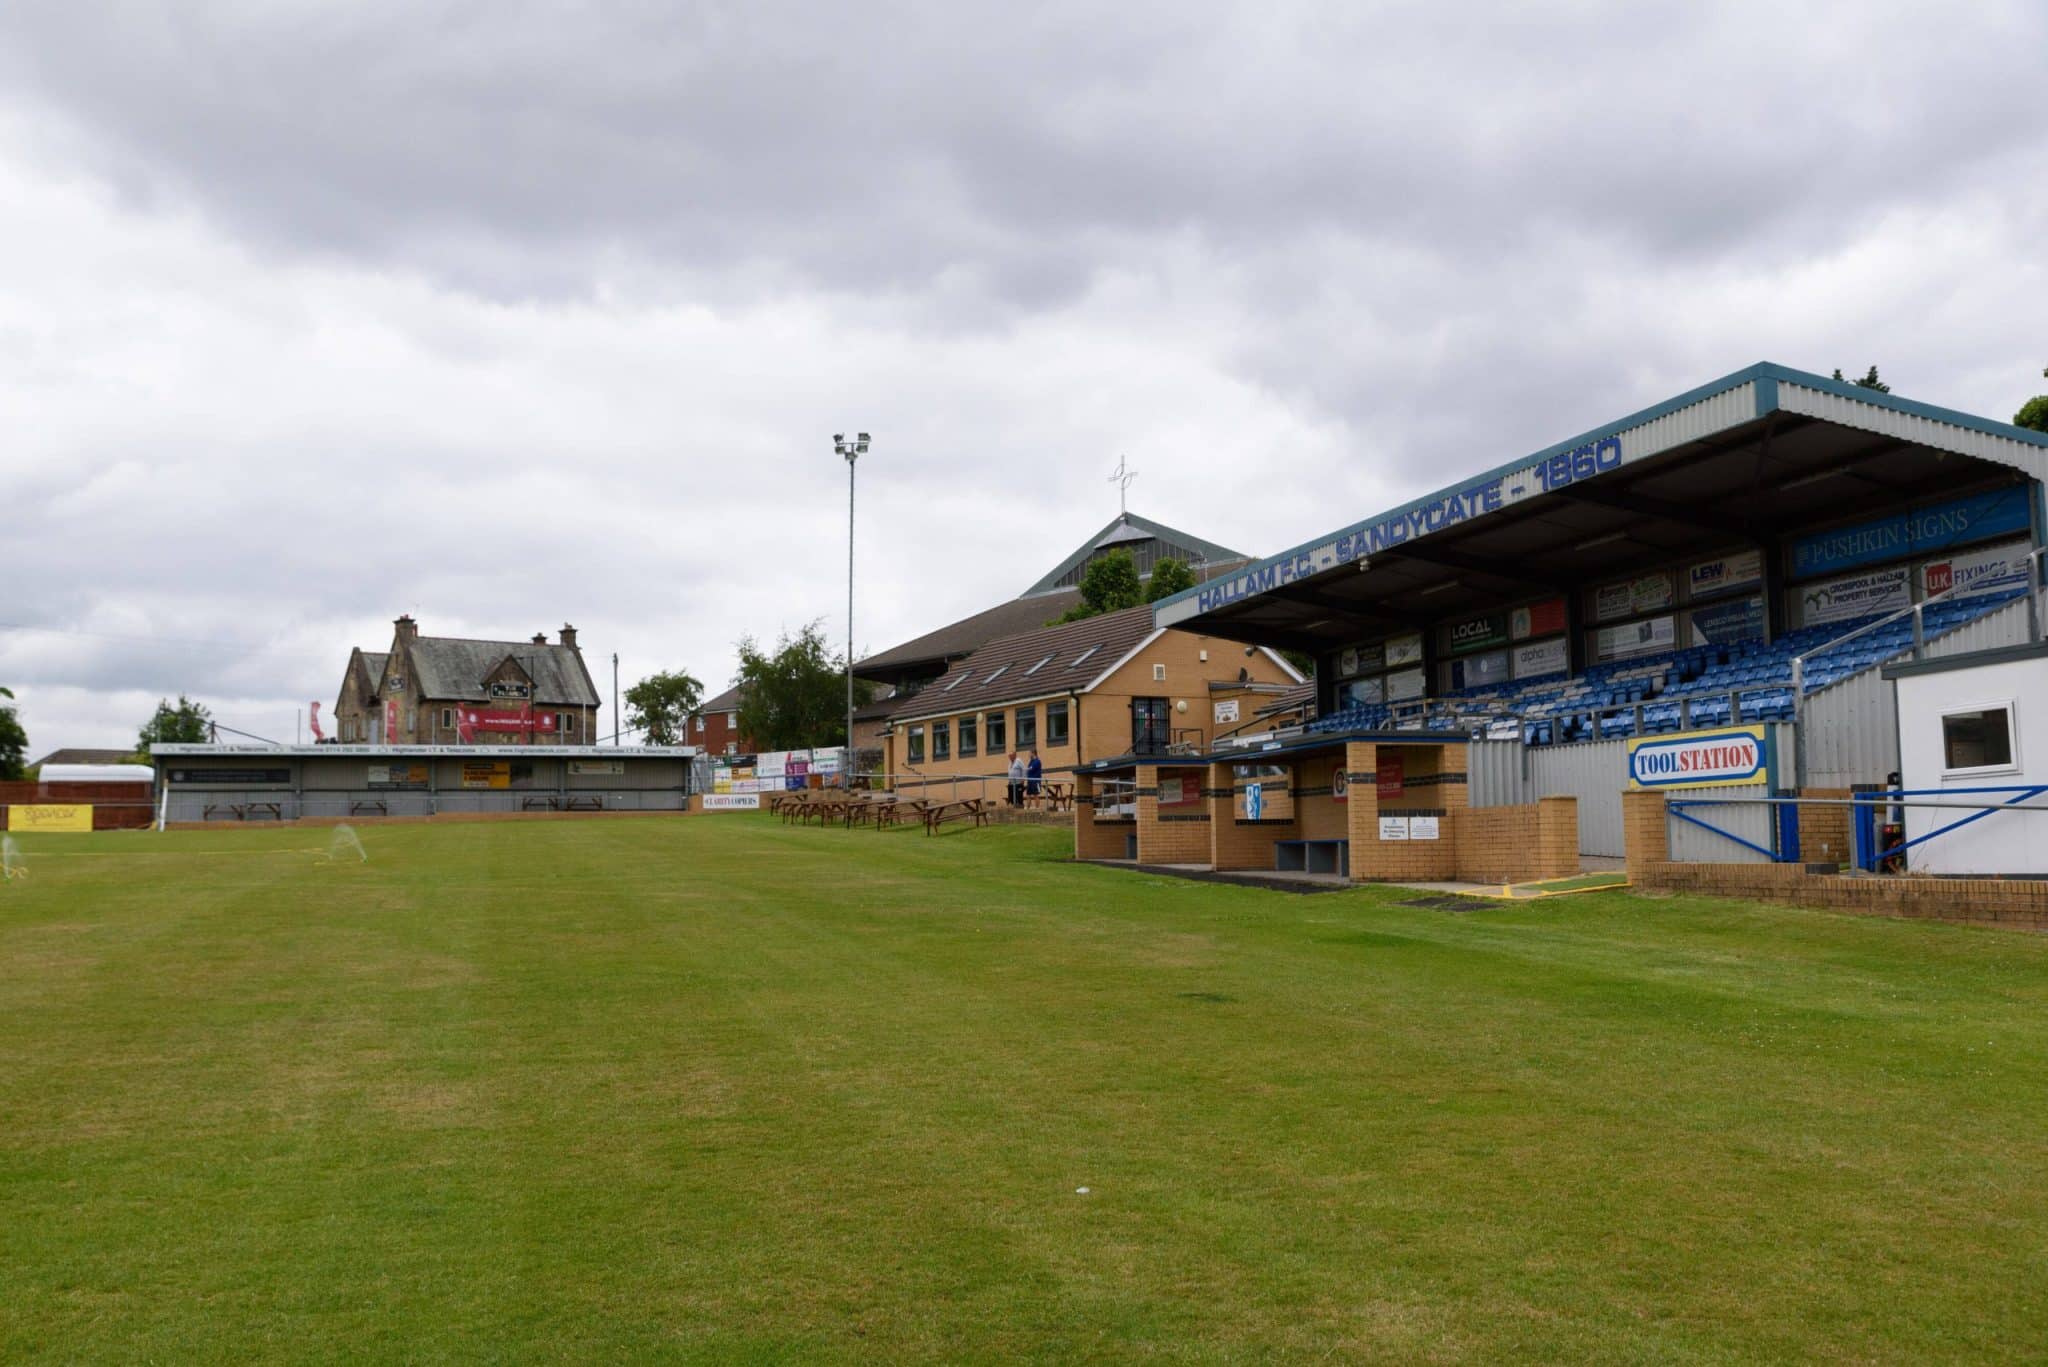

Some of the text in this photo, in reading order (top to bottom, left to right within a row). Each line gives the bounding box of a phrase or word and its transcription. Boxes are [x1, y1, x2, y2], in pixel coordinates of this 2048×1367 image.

[1198, 567, 1275, 613] HALLAM
[1280, 551, 1317, 584] F.C.
[1336, 479, 1502, 563] SANDYGATE
[1534, 438, 1622, 492] 1860
[1812, 508, 1969, 565] PUSHKIN SIGNS
[1834, 583, 1902, 604] PROPERTY SERVICES
[1452, 619, 1491, 639] LOCAL
[1637, 745, 1753, 775] TOOLSTATION
